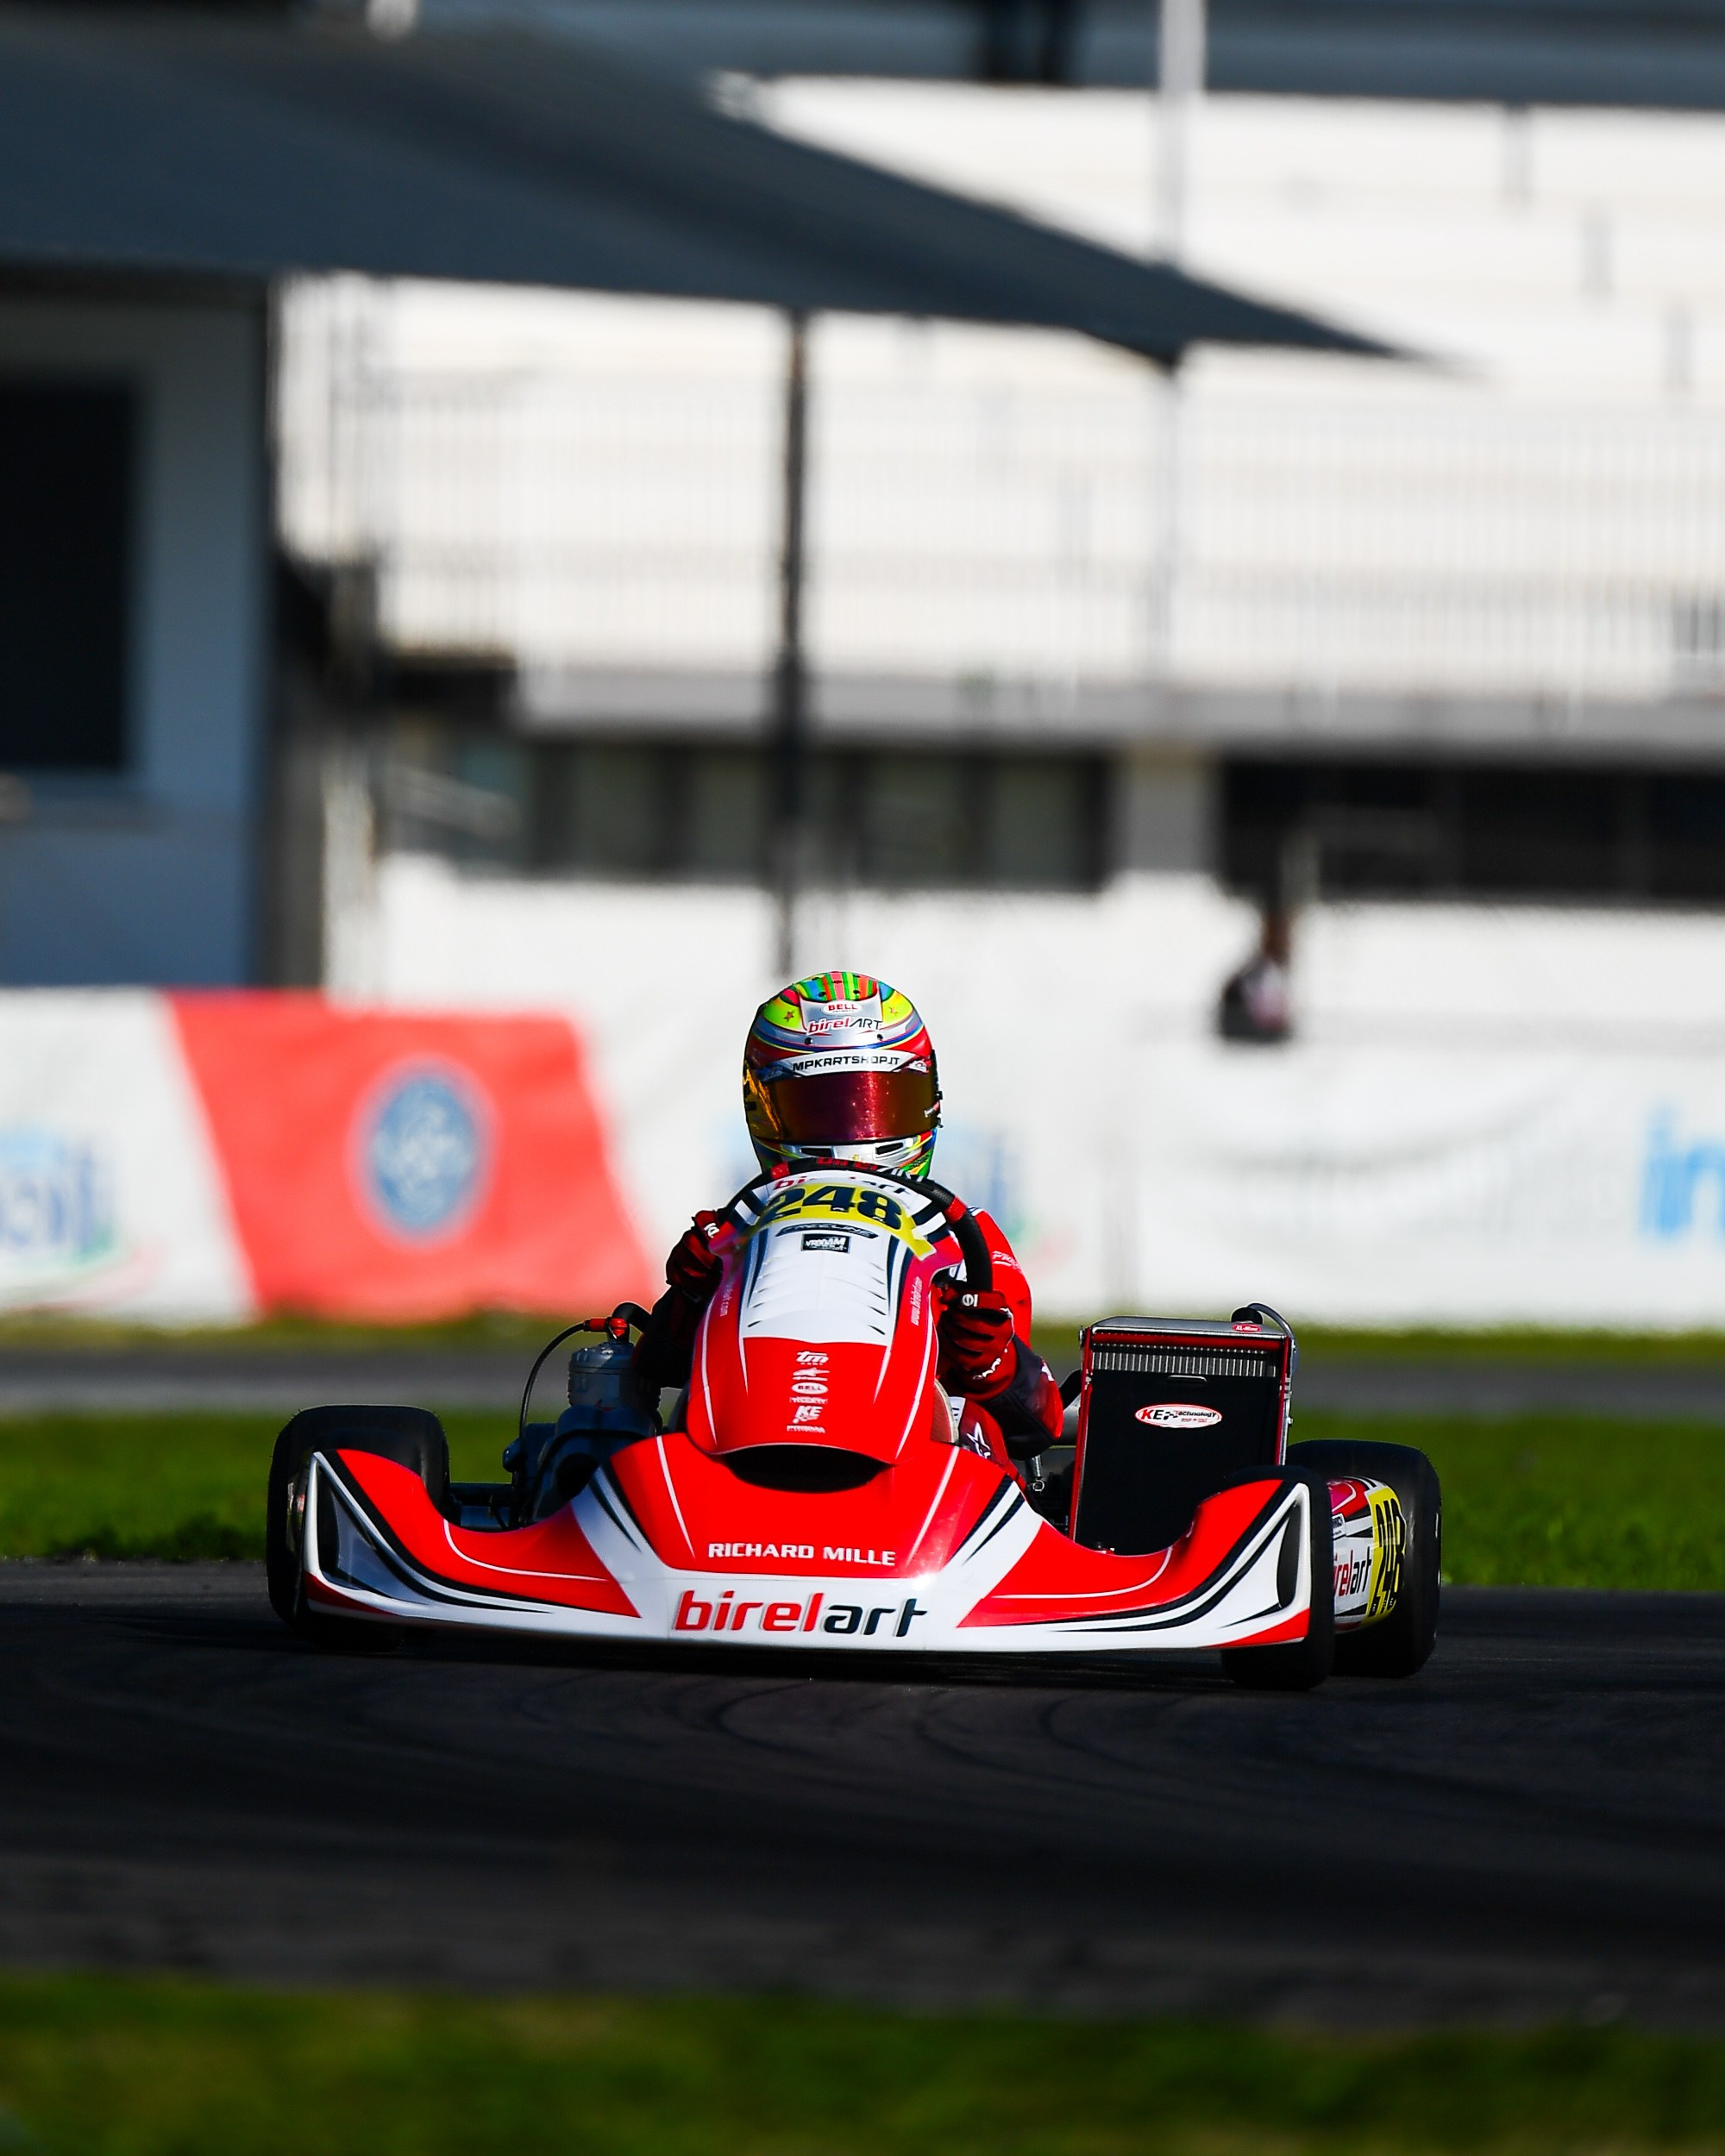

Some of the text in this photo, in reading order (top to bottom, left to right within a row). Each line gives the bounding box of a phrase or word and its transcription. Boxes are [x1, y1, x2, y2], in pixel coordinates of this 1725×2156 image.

[760, 1184, 903, 1231] 248
[707, 1542, 895, 1566] RICHARD MILLE
[673, 1589, 928, 1638] birelart
